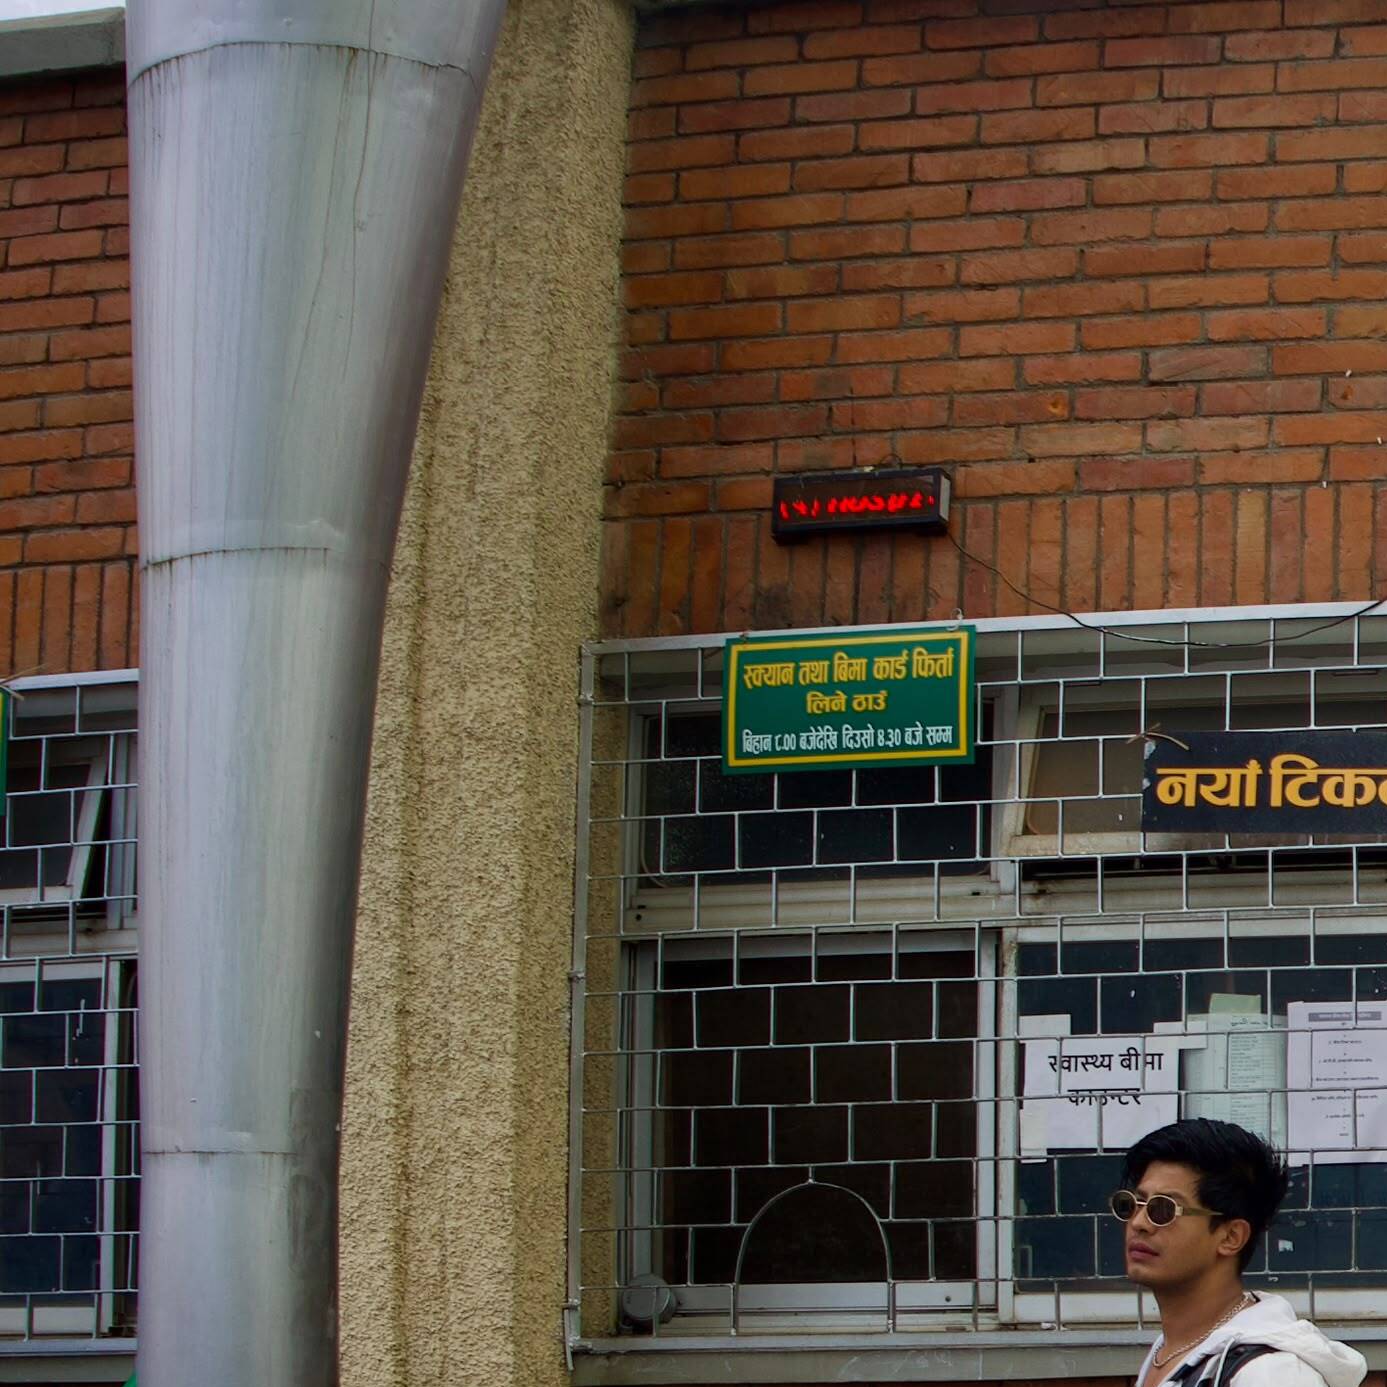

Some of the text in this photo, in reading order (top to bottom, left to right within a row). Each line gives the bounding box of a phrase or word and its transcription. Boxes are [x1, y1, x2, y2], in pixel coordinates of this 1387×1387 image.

[798, 660, 830, 685] तथा
[833, 650, 868, 682] बिमा
[873, 649, 909, 680] कार्ड
[806, 690, 846, 714] लिने
[742, 728, 772, 754] बिहान
[904, 721, 923, 745] बजे
[1048, 1046, 1164, 1073] स्वास्थ्य बीमा
